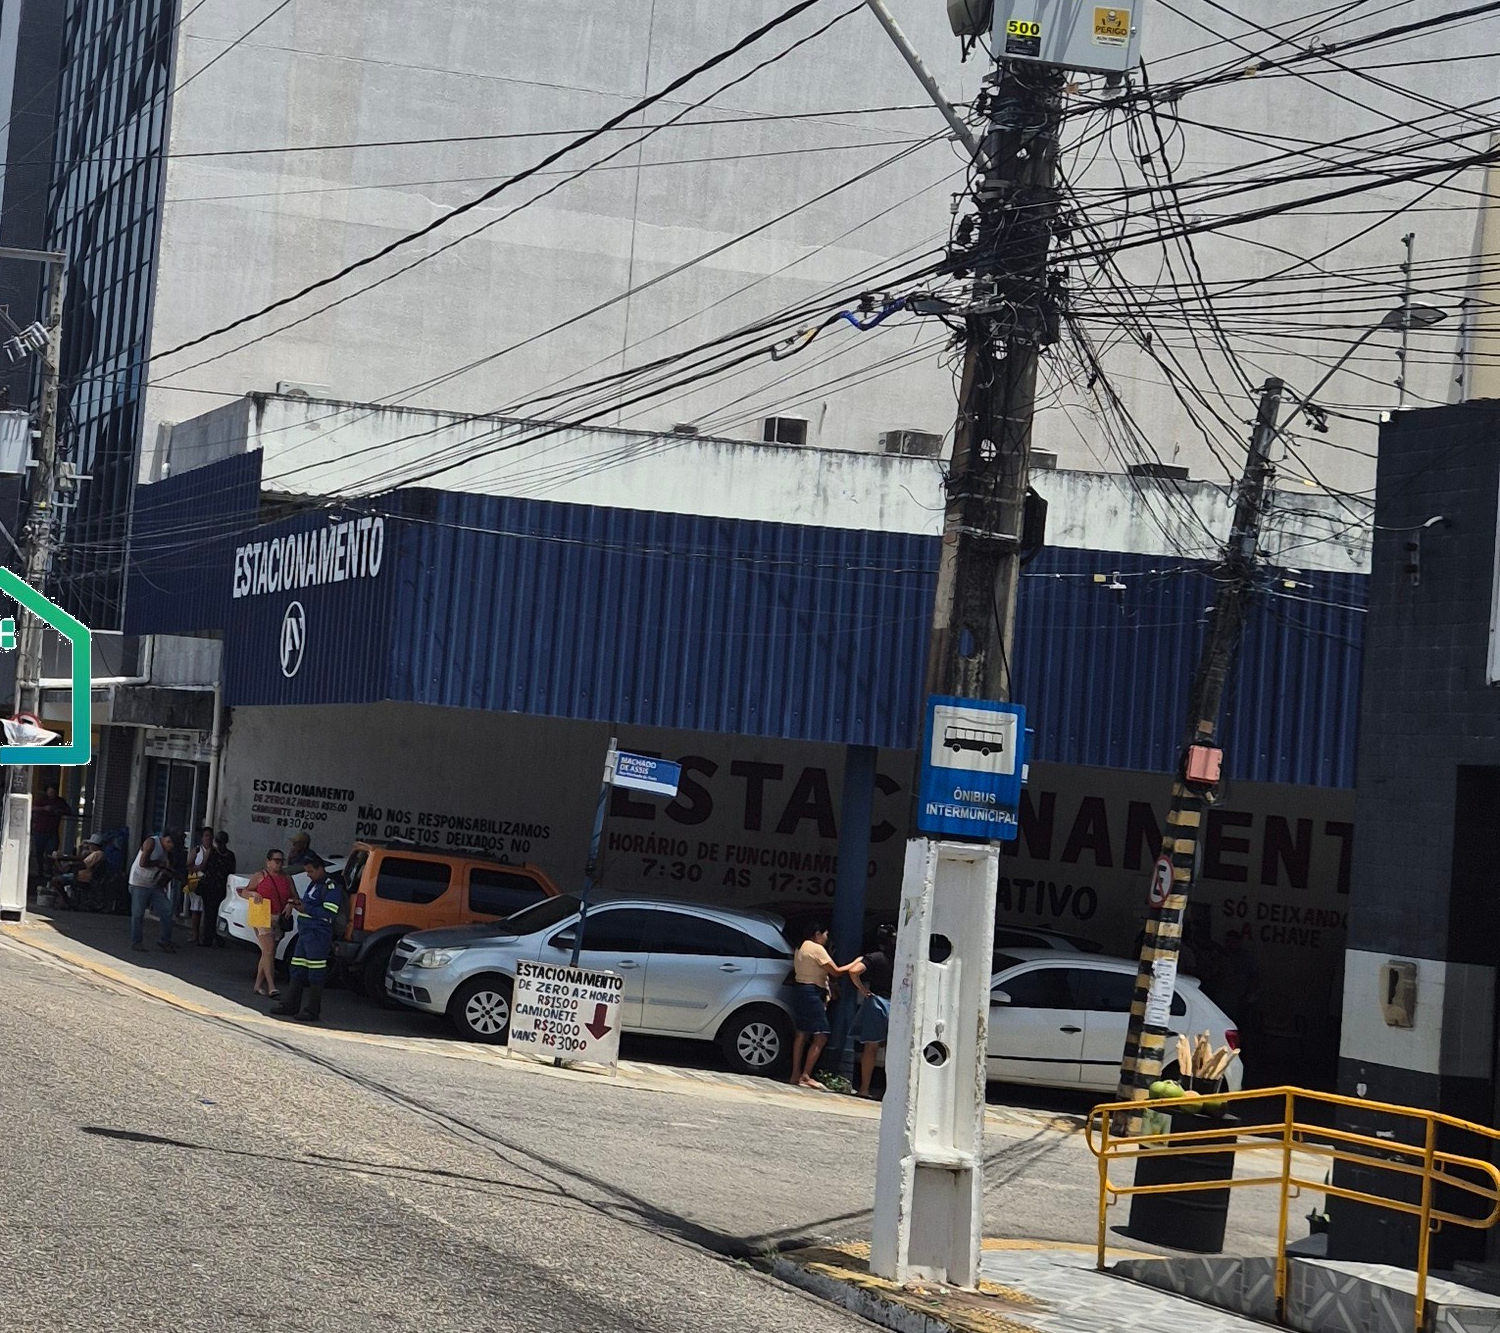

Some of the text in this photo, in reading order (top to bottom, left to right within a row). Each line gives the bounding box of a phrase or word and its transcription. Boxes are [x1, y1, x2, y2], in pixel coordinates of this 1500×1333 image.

[1008, 20, 1040, 36] 500
[1095, 25, 1128, 36] PERIGO
[233, 517, 384, 599] ESTACIONAMENTO
[619, 764, 649, 775] DE ASSIS
[621, 757, 657, 769] MACHADO
[253, 779, 355, 802] ESTACIONAMENTO
[254, 794, 263, 803] DE
[264, 795, 285, 806] ZERO
[953, 786, 997, 804] ÔNIBUS
[357, 804, 551, 840] NÃO NOS RESPONSABILIZAMOS
[926, 803, 1018, 826] INTERMUNICIPAL
[356, 821, 378, 837] POR
[384, 824, 440, 844] OBJETOS
[446, 831, 504, 851] DEIXADOS
[510, 839, 531, 854] NO
[609, 832, 689, 858] HORÁRIO
[697, 841, 718, 863] DE
[641, 857, 703, 883] 7:30
[1222, 895, 1249, 918] SÓ
[1260, 924, 1322, 950] CHAVE
[516, 962, 623, 990] ESTACIONAMENTO
[519, 978, 532, 991] DE
[536, 981, 570, 997] ZERO
[589, 990, 621, 1005] HORAS
[515, 1003, 577, 1023] CAMIONETE
[511, 1029, 538, 1043] VANS
